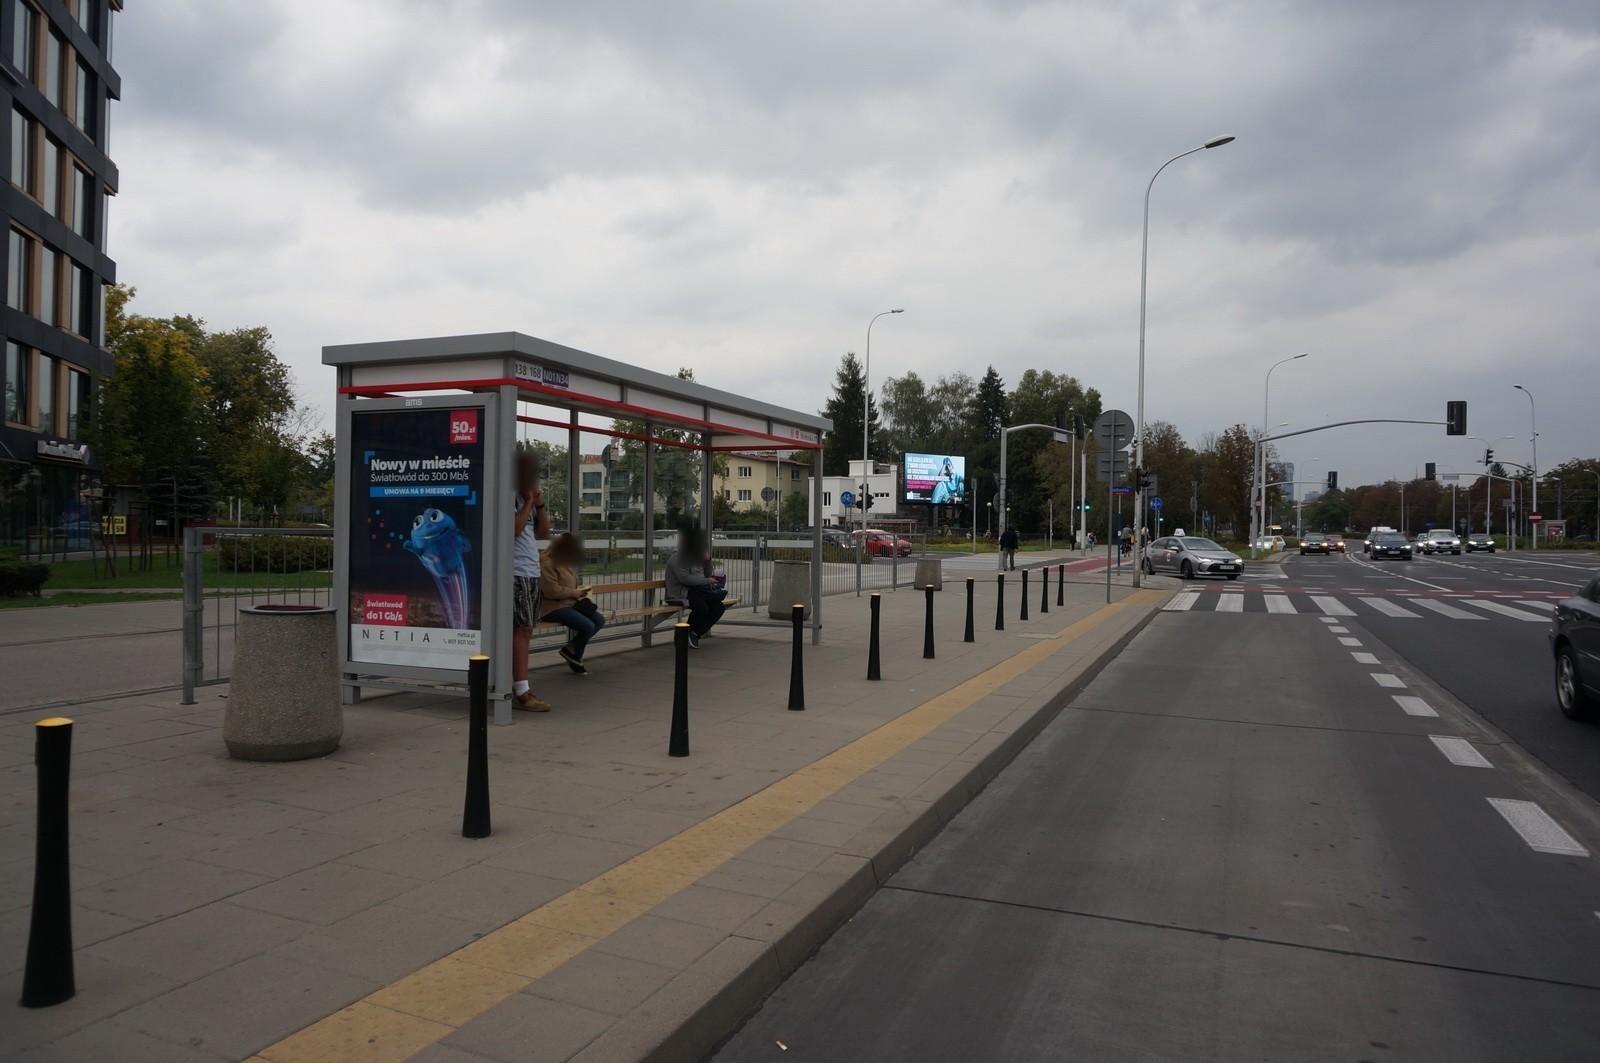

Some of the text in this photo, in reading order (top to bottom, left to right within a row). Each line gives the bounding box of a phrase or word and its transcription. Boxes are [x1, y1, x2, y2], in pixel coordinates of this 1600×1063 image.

[514, 363, 527, 376] 138
[530, 367, 542, 379] 168
[405, 398, 423, 407] ams
[452, 421, 469, 434] 50
[371, 454, 471, 473] Nowy w mieście
[370, 470, 469, 483] Światłowód do 300 Mb/s
[384, 488, 410, 496] UMOWA
[425, 487, 455, 496] MIESIĘCY
[366, 600, 403, 609] Światłowód
[366, 611, 403, 622] do 1 Gb/s
[362, 629, 431, 643] NETIA
